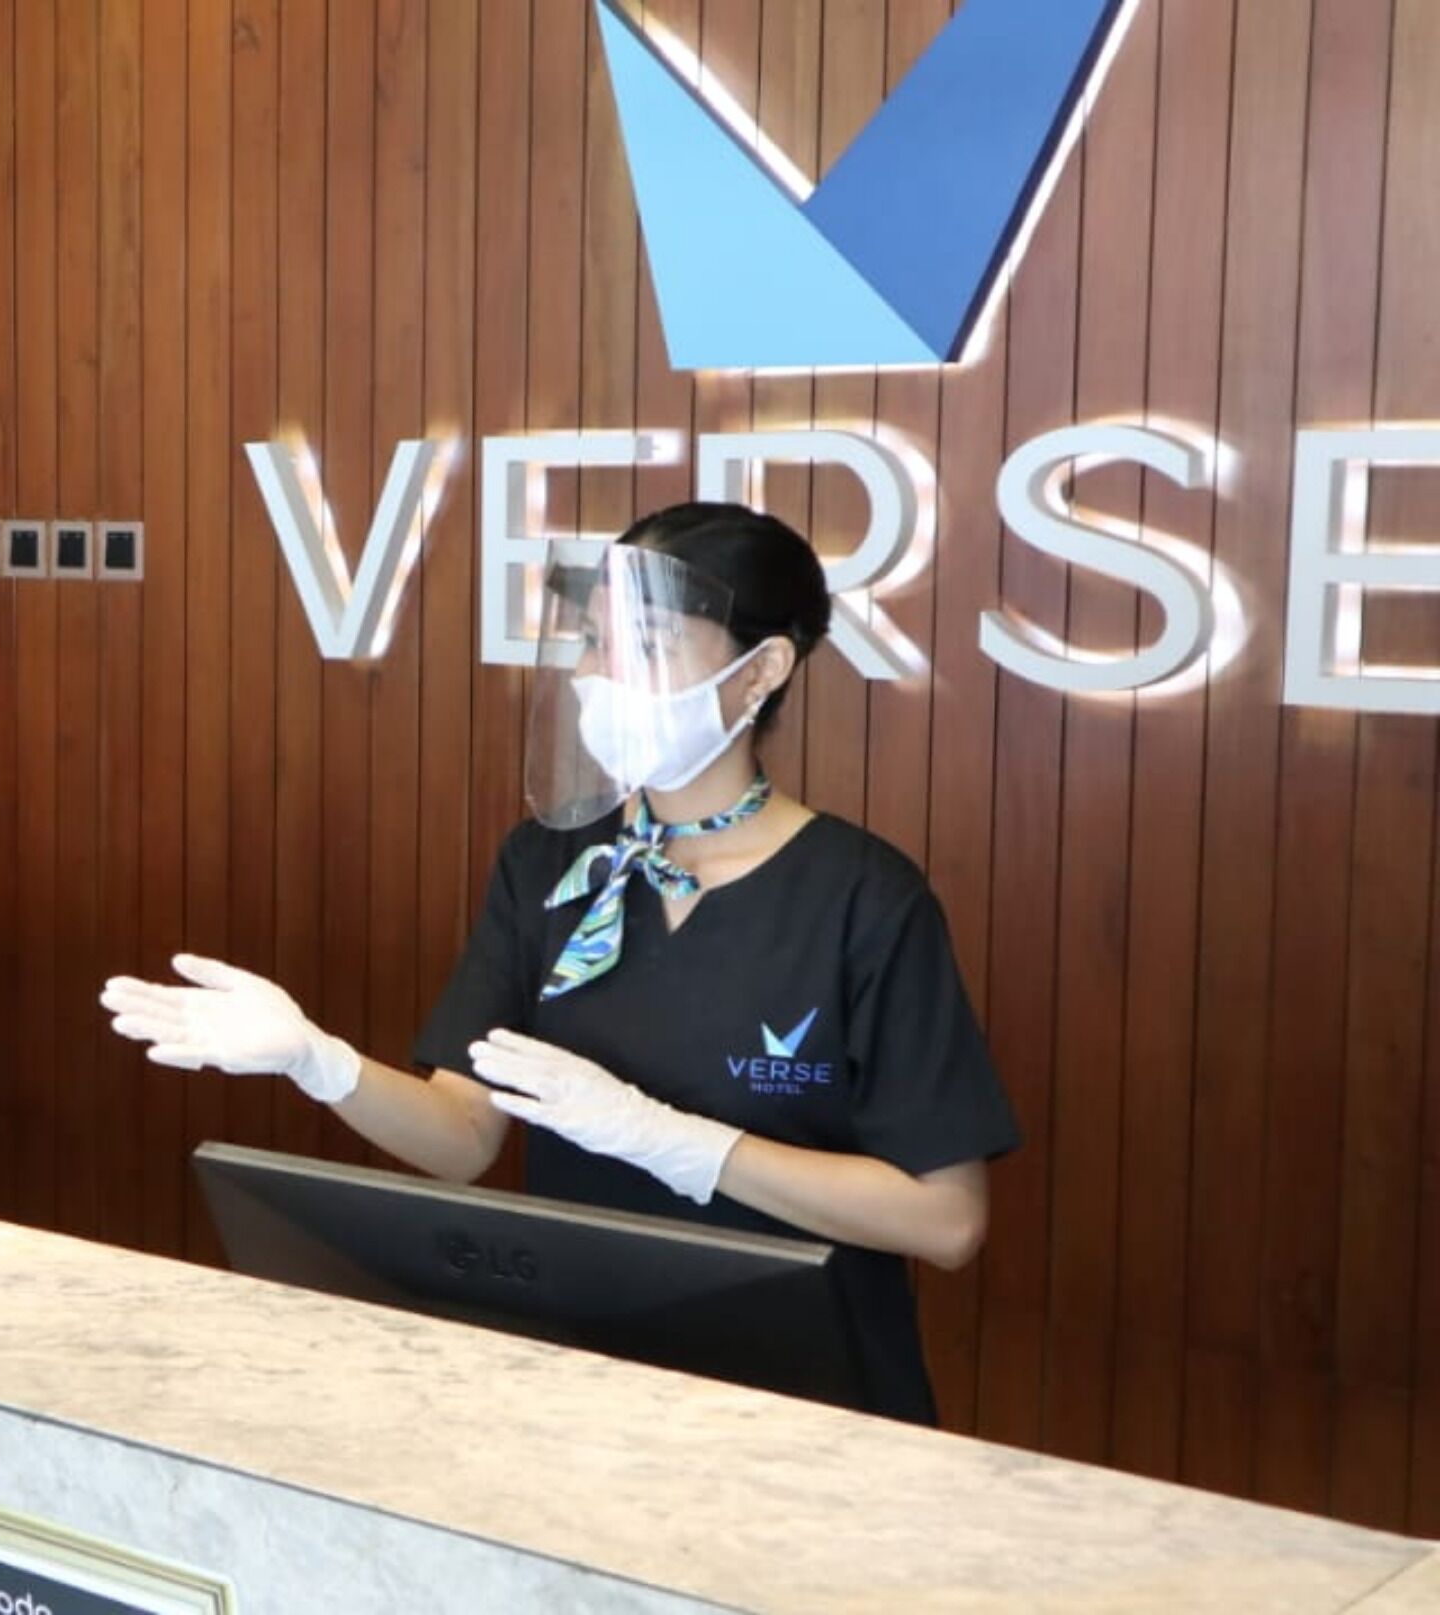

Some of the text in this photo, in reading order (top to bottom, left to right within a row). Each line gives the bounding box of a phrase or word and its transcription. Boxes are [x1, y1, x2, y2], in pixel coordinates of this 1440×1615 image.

[244, 424, 1440, 714] VERSE
[726, 1054, 832, 1084] VERSE
[750, 1081, 804, 1095] HOTEL
